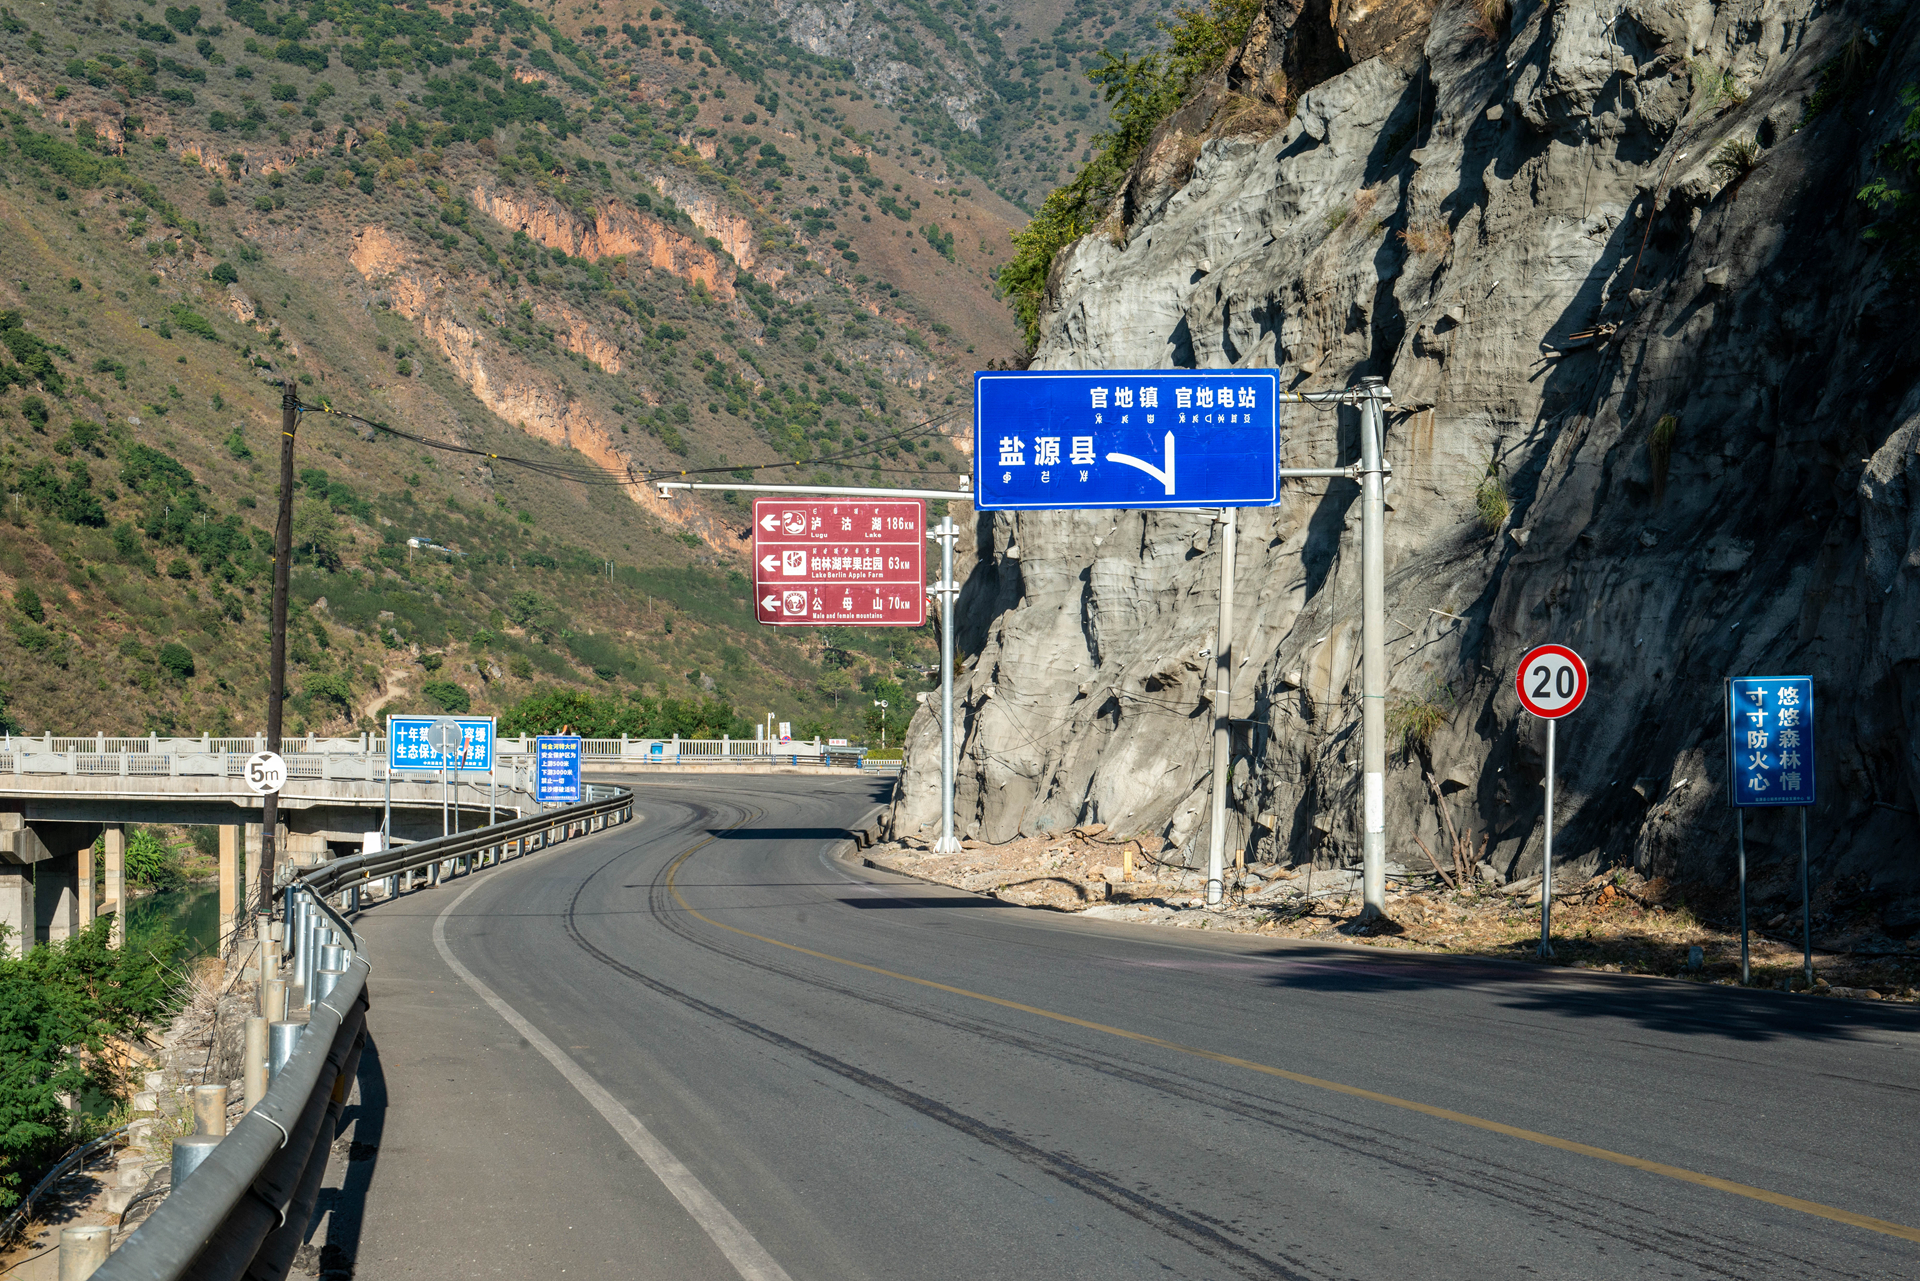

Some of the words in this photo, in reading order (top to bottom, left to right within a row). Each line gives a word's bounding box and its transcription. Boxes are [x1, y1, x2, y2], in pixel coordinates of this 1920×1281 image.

[1090, 386, 1159, 409] 官地镇
[1175, 386, 1256, 409] 官地电站
[998, 435, 1096, 466] 盐源县
[811, 516, 882, 531] 泸沽湖
[811, 557, 883, 571] 柏林湖苹果庄园
[811, 571, 826, 579] Lake
[828, 571, 847, 579] Berlin
[849, 571, 867, 580] Apple
[868, 571, 884, 579] Farm
[812, 597, 883, 611] 公母山
[837, 611, 855, 619] female
[1532, 665, 1574, 698] 20
[397, 726, 486, 743] 十年禁容缓
[1745, 686, 1770, 791] 寸寸防火心
[1777, 686, 1801, 791] 悠悠森林情
[251, 763, 279, 783] 5m
